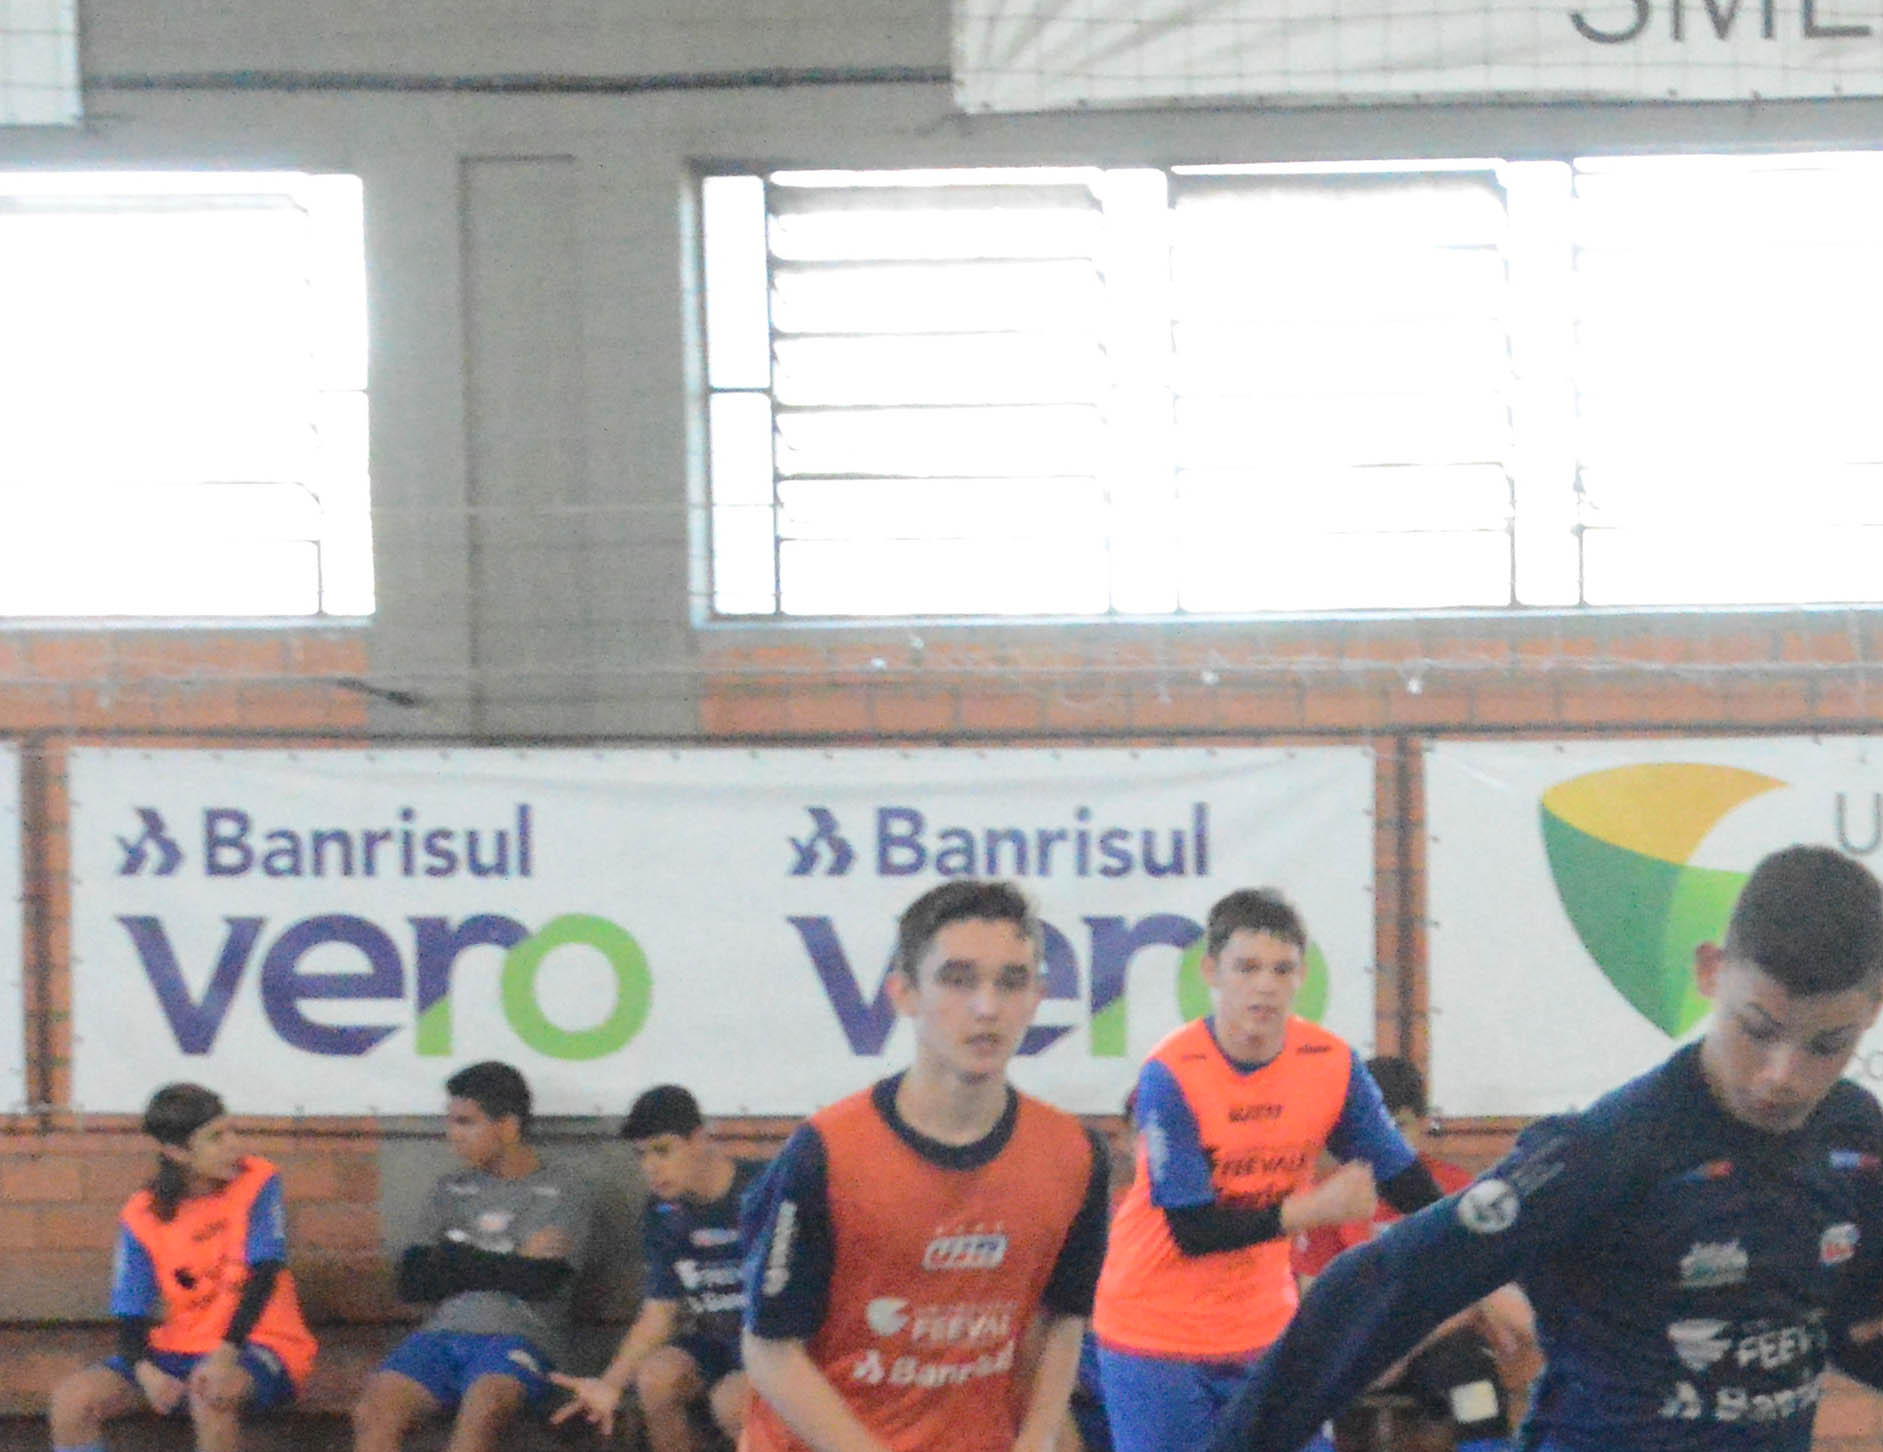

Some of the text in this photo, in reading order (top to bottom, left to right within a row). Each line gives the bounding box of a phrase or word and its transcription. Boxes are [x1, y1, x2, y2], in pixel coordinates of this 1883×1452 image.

[203, 803, 532, 877] Banrisul
[874, 802, 1211, 877] Banrisul
[115, 912, 654, 1061] vero
[786, 912, 1331, 1057] vr
